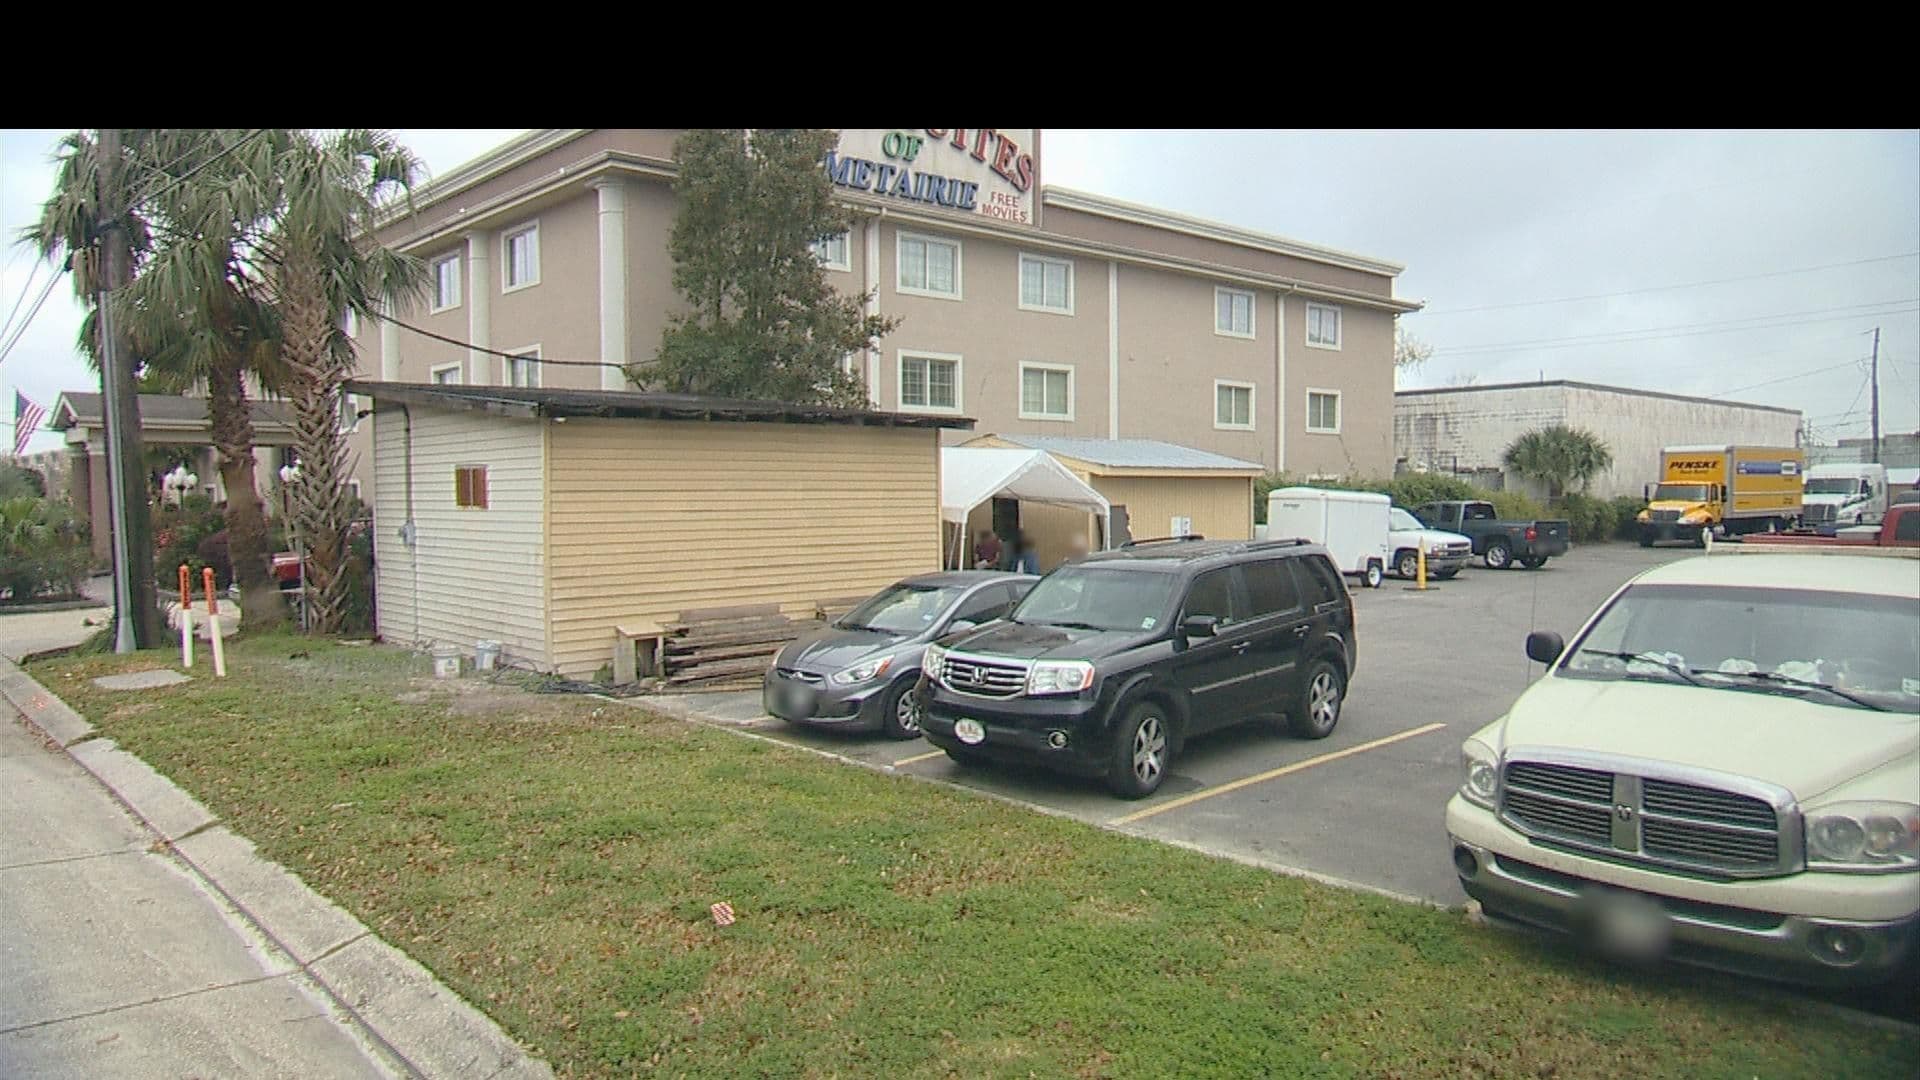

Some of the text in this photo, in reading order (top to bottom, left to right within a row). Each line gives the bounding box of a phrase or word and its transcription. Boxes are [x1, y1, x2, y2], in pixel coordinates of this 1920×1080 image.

[883, 131, 924, 162] OF
[925, 129, 1033, 192] ITES
[826, 151, 980, 210] METAIRIE
[991, 191, 1021, 208] FREE
[981, 203, 1028, 222] MOVIES
[1669, 461, 1719, 470] PENSKE
